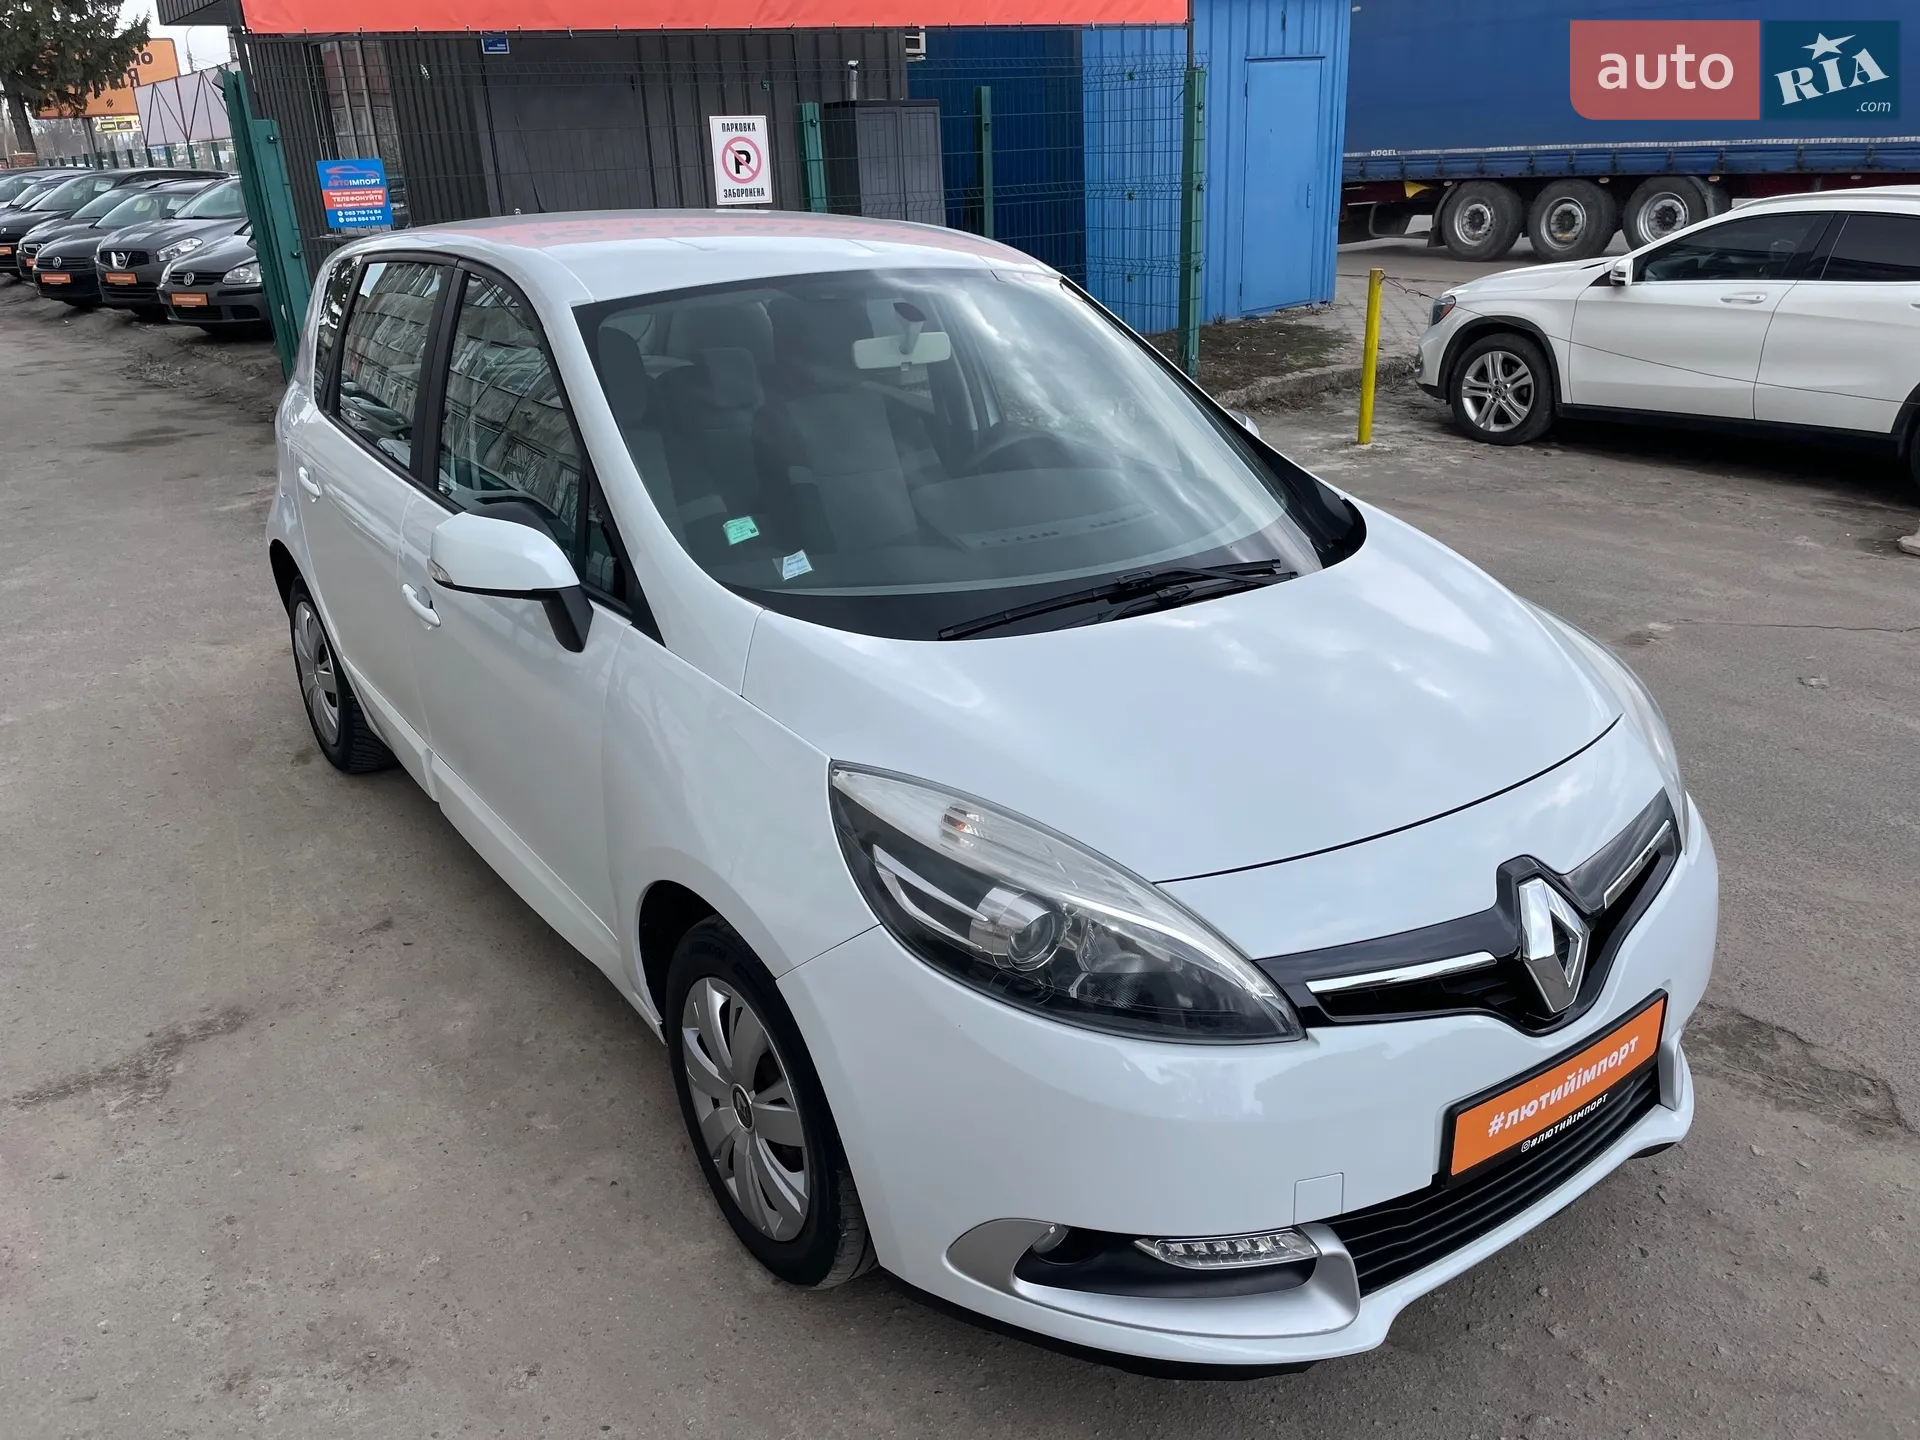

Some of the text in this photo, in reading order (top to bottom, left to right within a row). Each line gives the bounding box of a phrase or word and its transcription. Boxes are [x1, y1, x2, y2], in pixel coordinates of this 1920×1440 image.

[721, 122, 757, 133] ПАРКОВКА
[328, 178, 380, 186] АВТОІМПОРТ
[723, 187, 766, 199] ЗАБОРОНЕНА
[1487, 1035, 1640, 1138] #лютийімпорт
[1530, 1093, 1609, 1148] #ЛЮТИЙІМПОРТ
